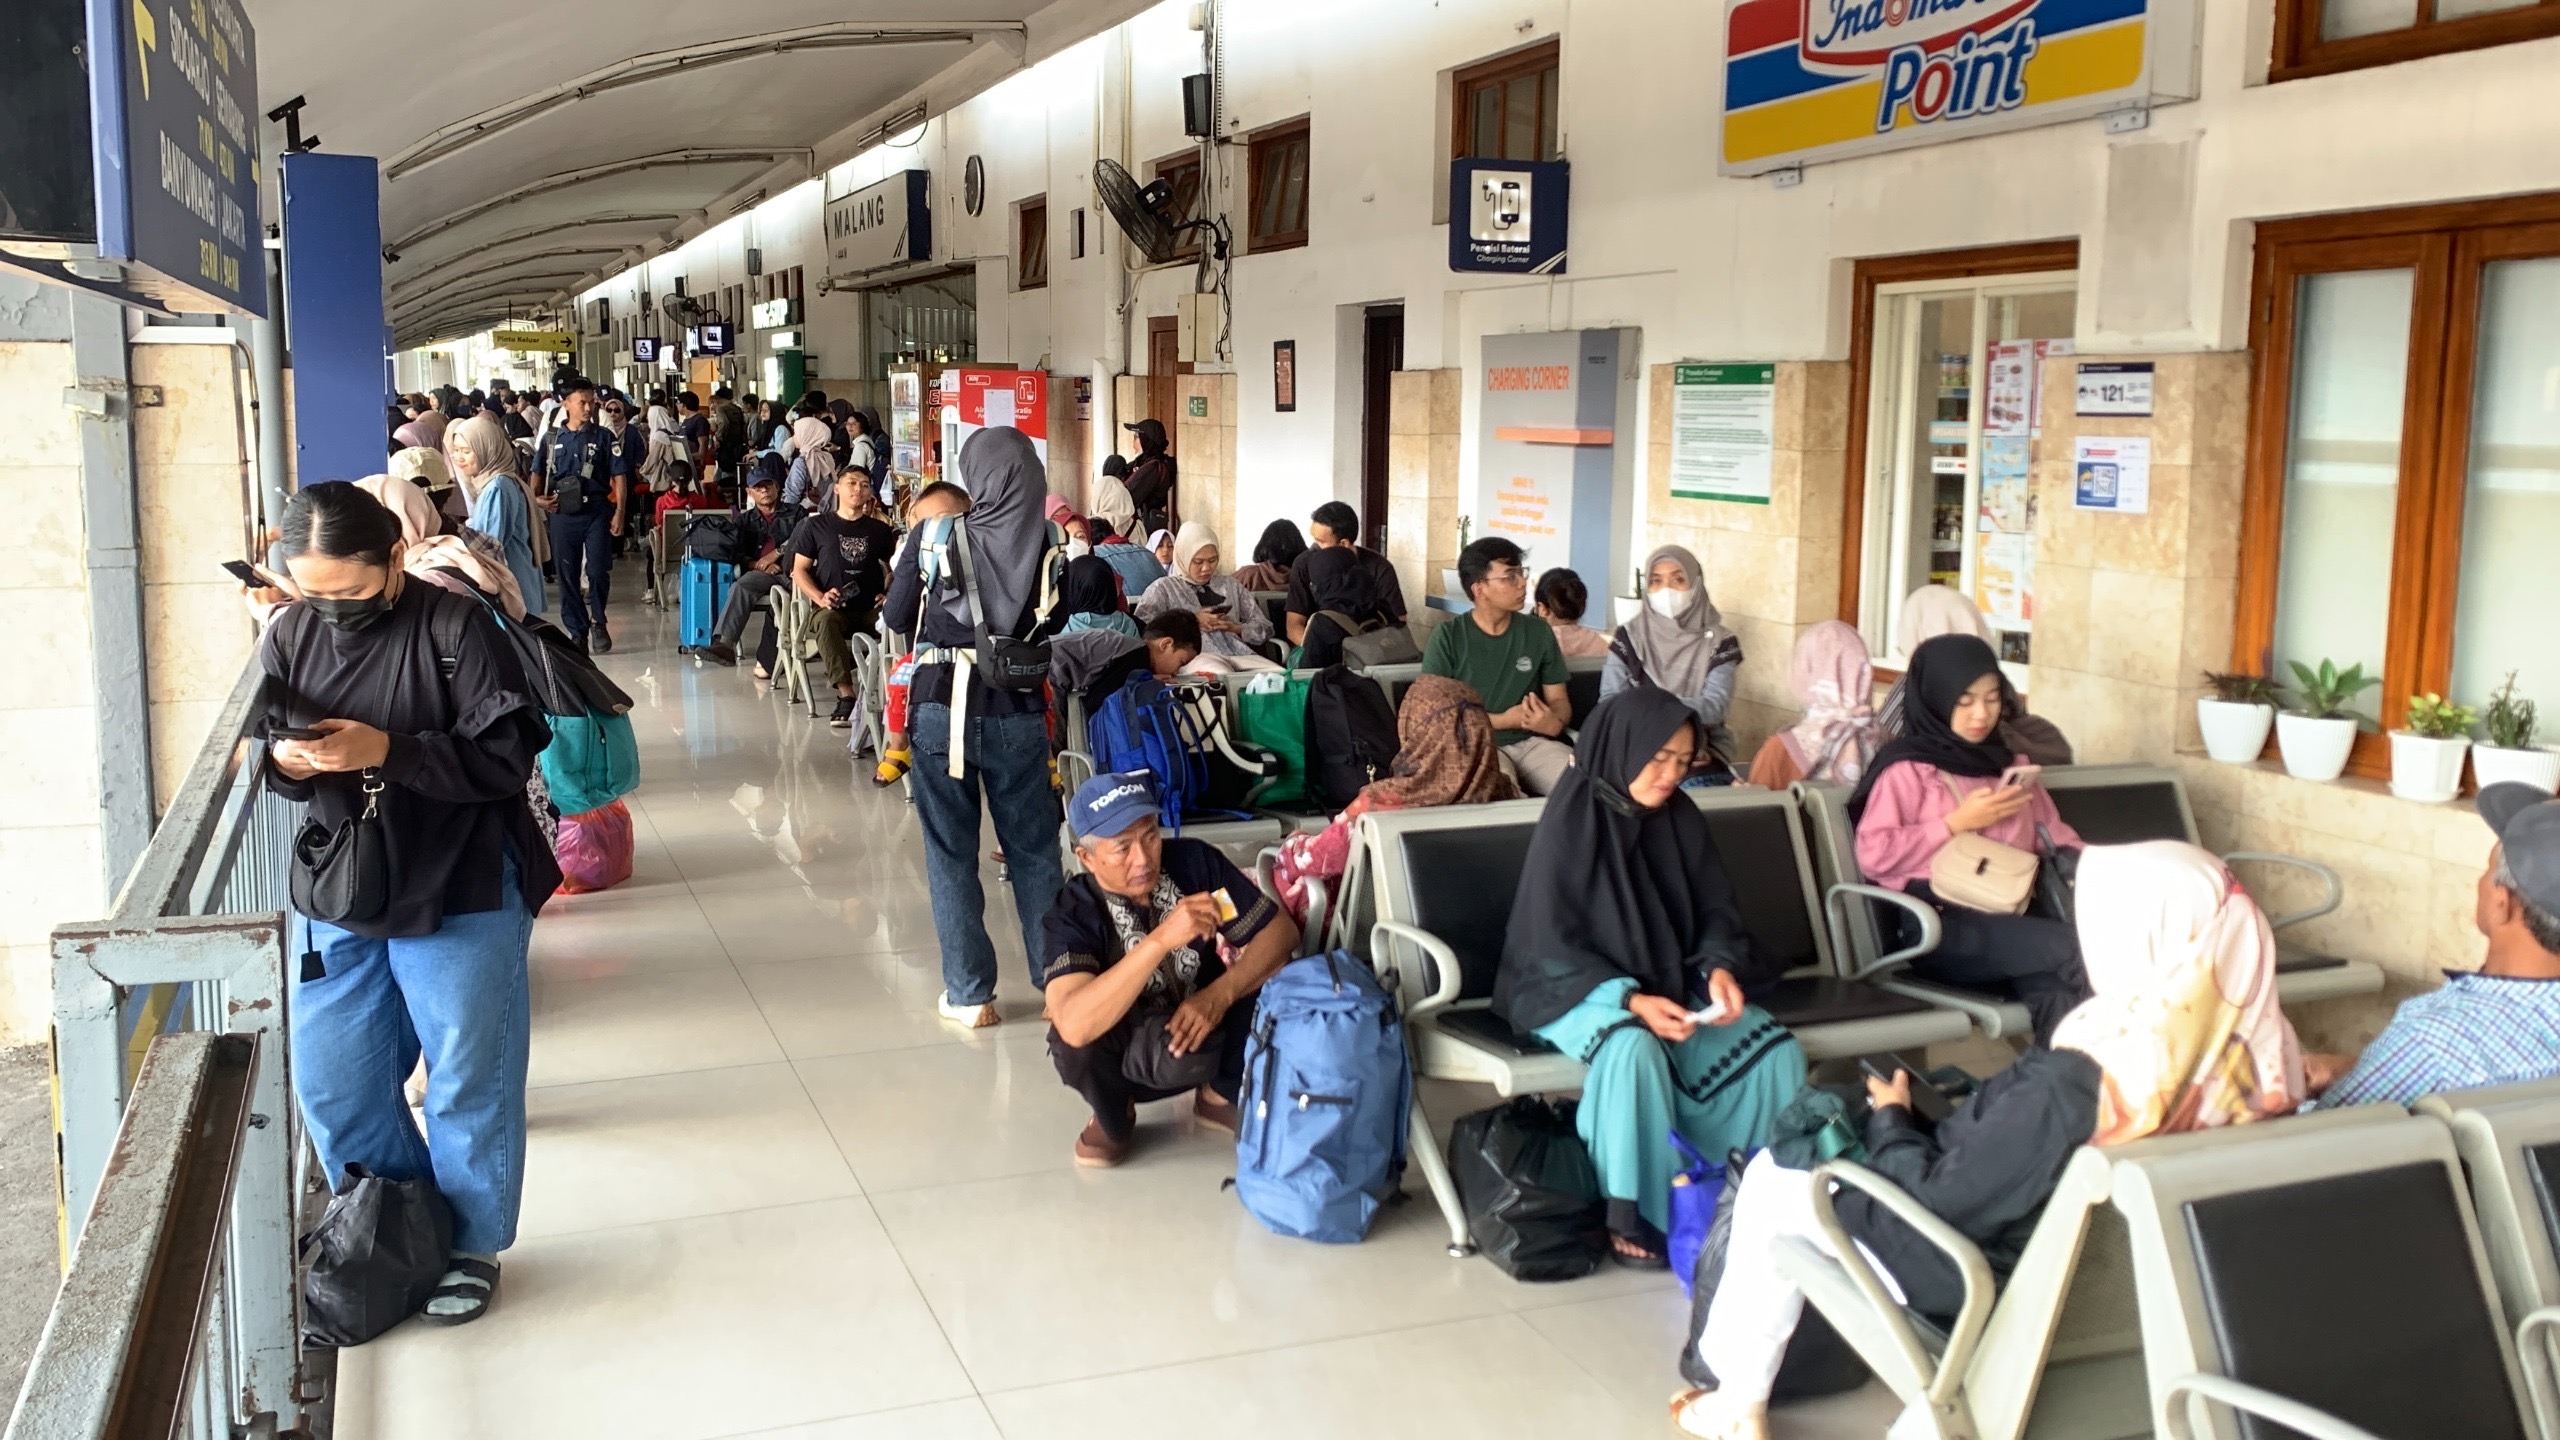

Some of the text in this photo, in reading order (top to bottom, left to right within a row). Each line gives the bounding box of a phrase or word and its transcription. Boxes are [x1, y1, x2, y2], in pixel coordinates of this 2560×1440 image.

[169, 5, 210, 106] SIDOARJO
[1879, 22, 2036, 129] Point
[160, 129, 216, 228] BANYUWANGI
[222, 191, 247, 251] JAKARTA
[834, 194, 884, 240] MALANG
[1470, 243, 1530, 254] Pengisi Baterai
[1476, 254, 1530, 264] Charging Corner
[1488, 365, 1569, 391] CHARGING CORNER
[2101, 384, 2124, 402] 121
[1009, 661, 1049, 676] EIGE
